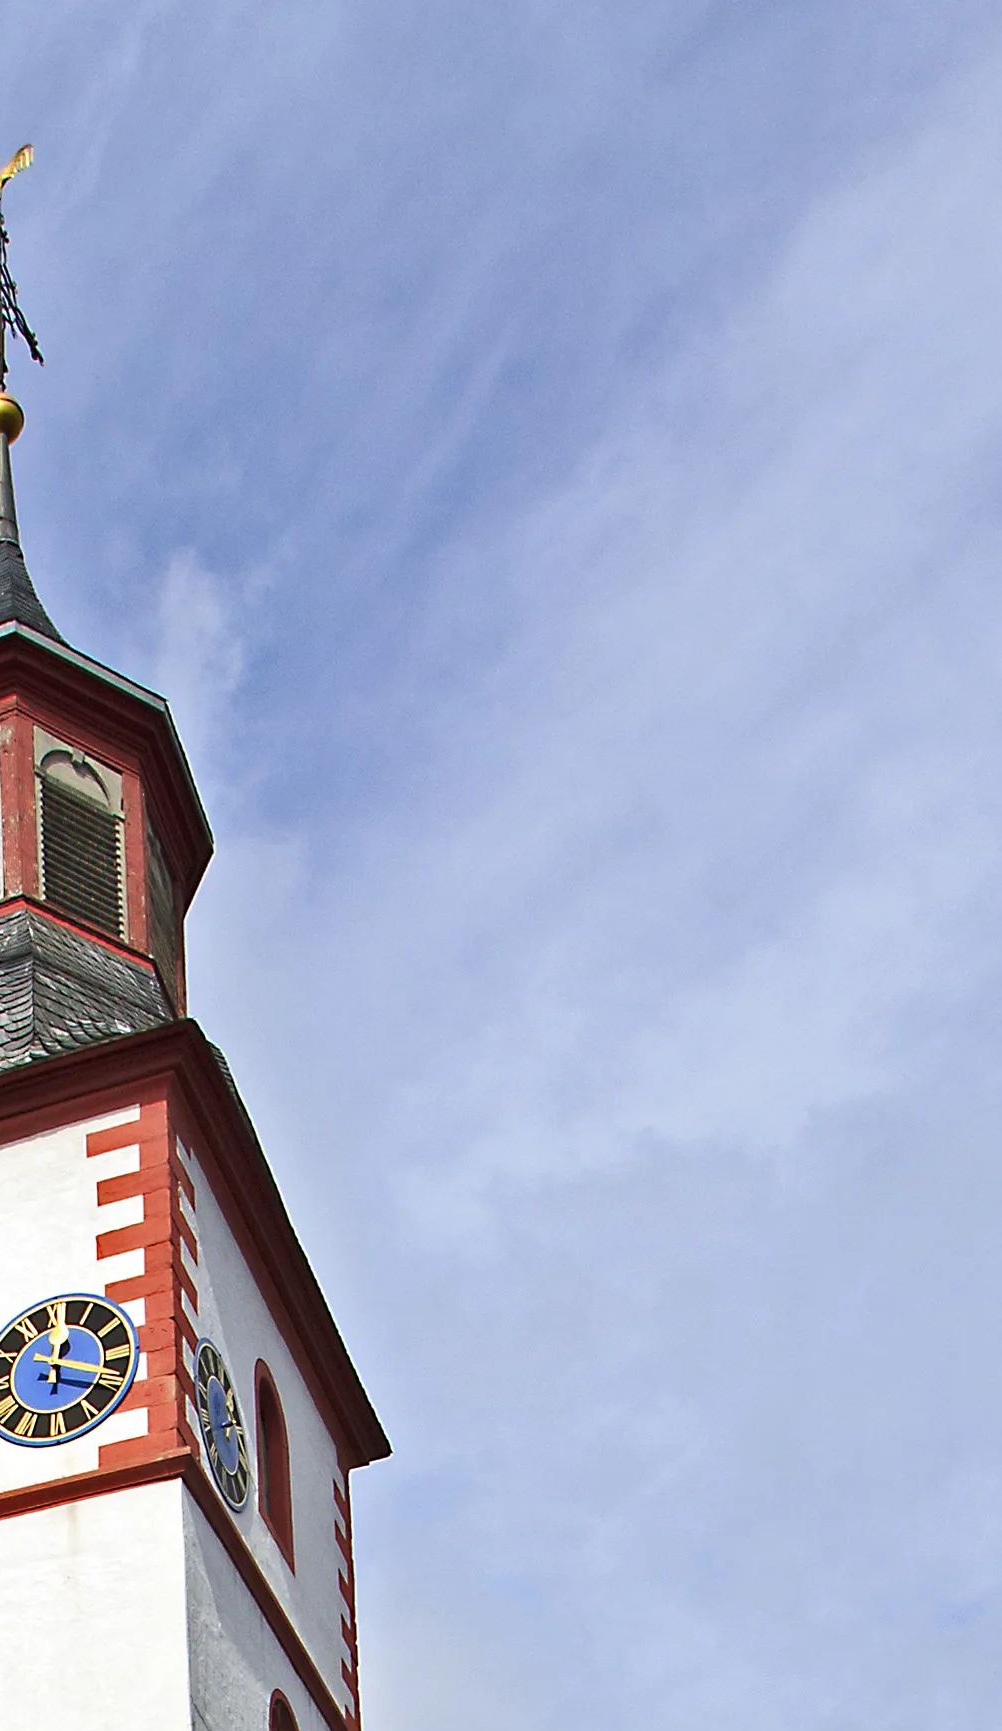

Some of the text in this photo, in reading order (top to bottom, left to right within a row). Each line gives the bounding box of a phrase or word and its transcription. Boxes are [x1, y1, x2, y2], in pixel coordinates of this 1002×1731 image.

[79, 1302, 94, 1325] I
[14, 1317, 38, 1343] XI
[97, 1317, 121, 1338] II
[105, 1344, 130, 1361] III
[80, 1399, 99, 1420] V
[13, 1411, 38, 1437] VII
[50, 1411, 67, 1437] VI
